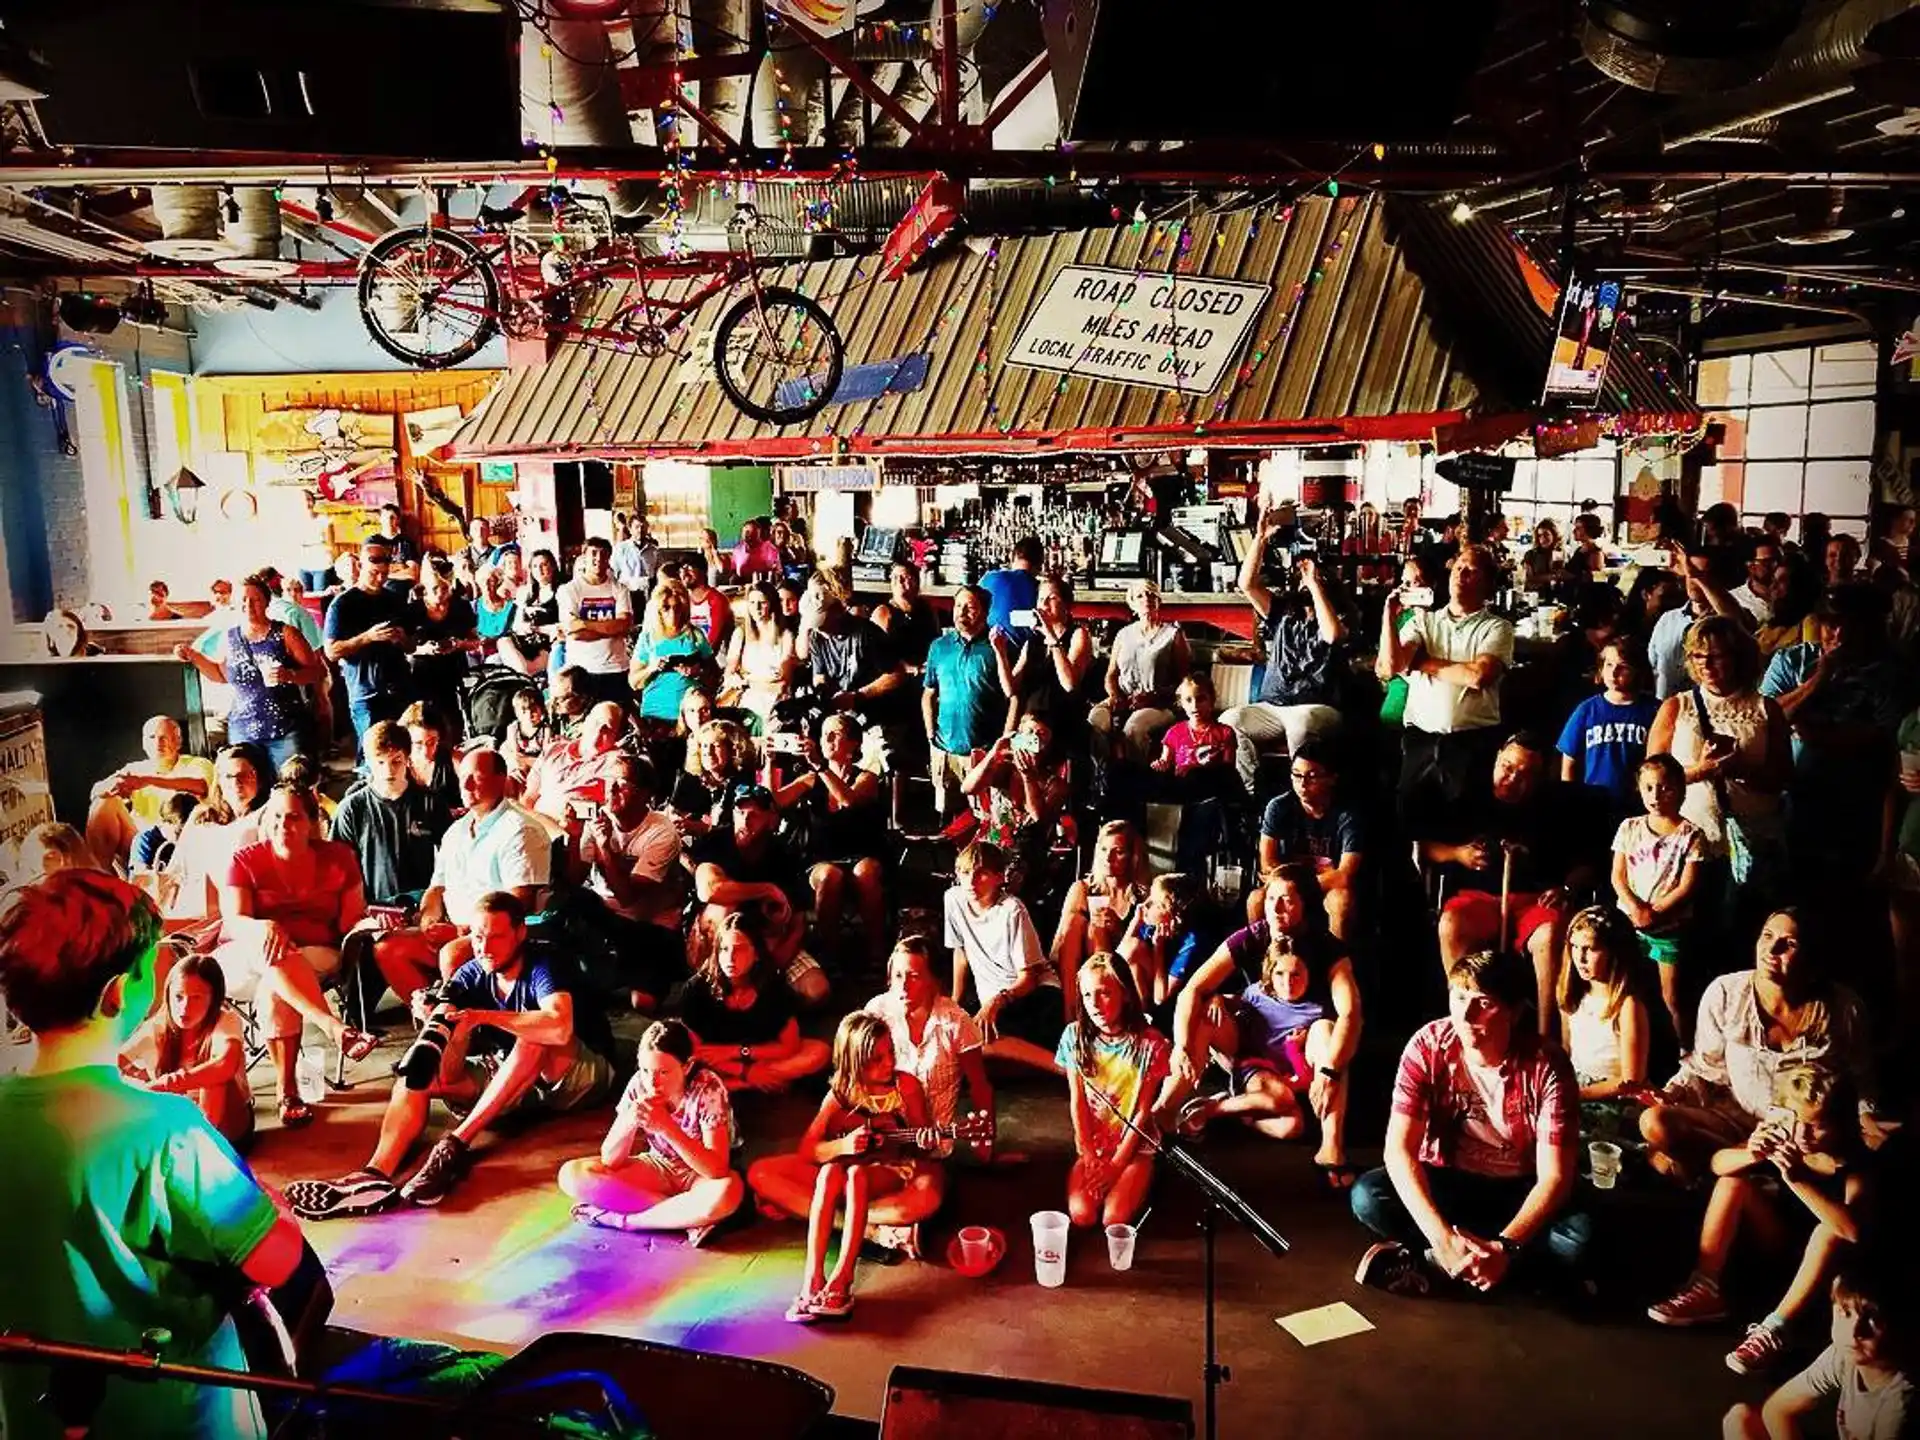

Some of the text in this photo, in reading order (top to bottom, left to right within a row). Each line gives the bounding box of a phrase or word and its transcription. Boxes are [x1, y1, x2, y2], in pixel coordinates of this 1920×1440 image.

[1073, 277, 1244, 316] ROAD CLOSED
[1081, 315, 1213, 350] MILES AHEAD
[1028, 338, 1207, 379] LOCAL TRAFFIC ONLY
